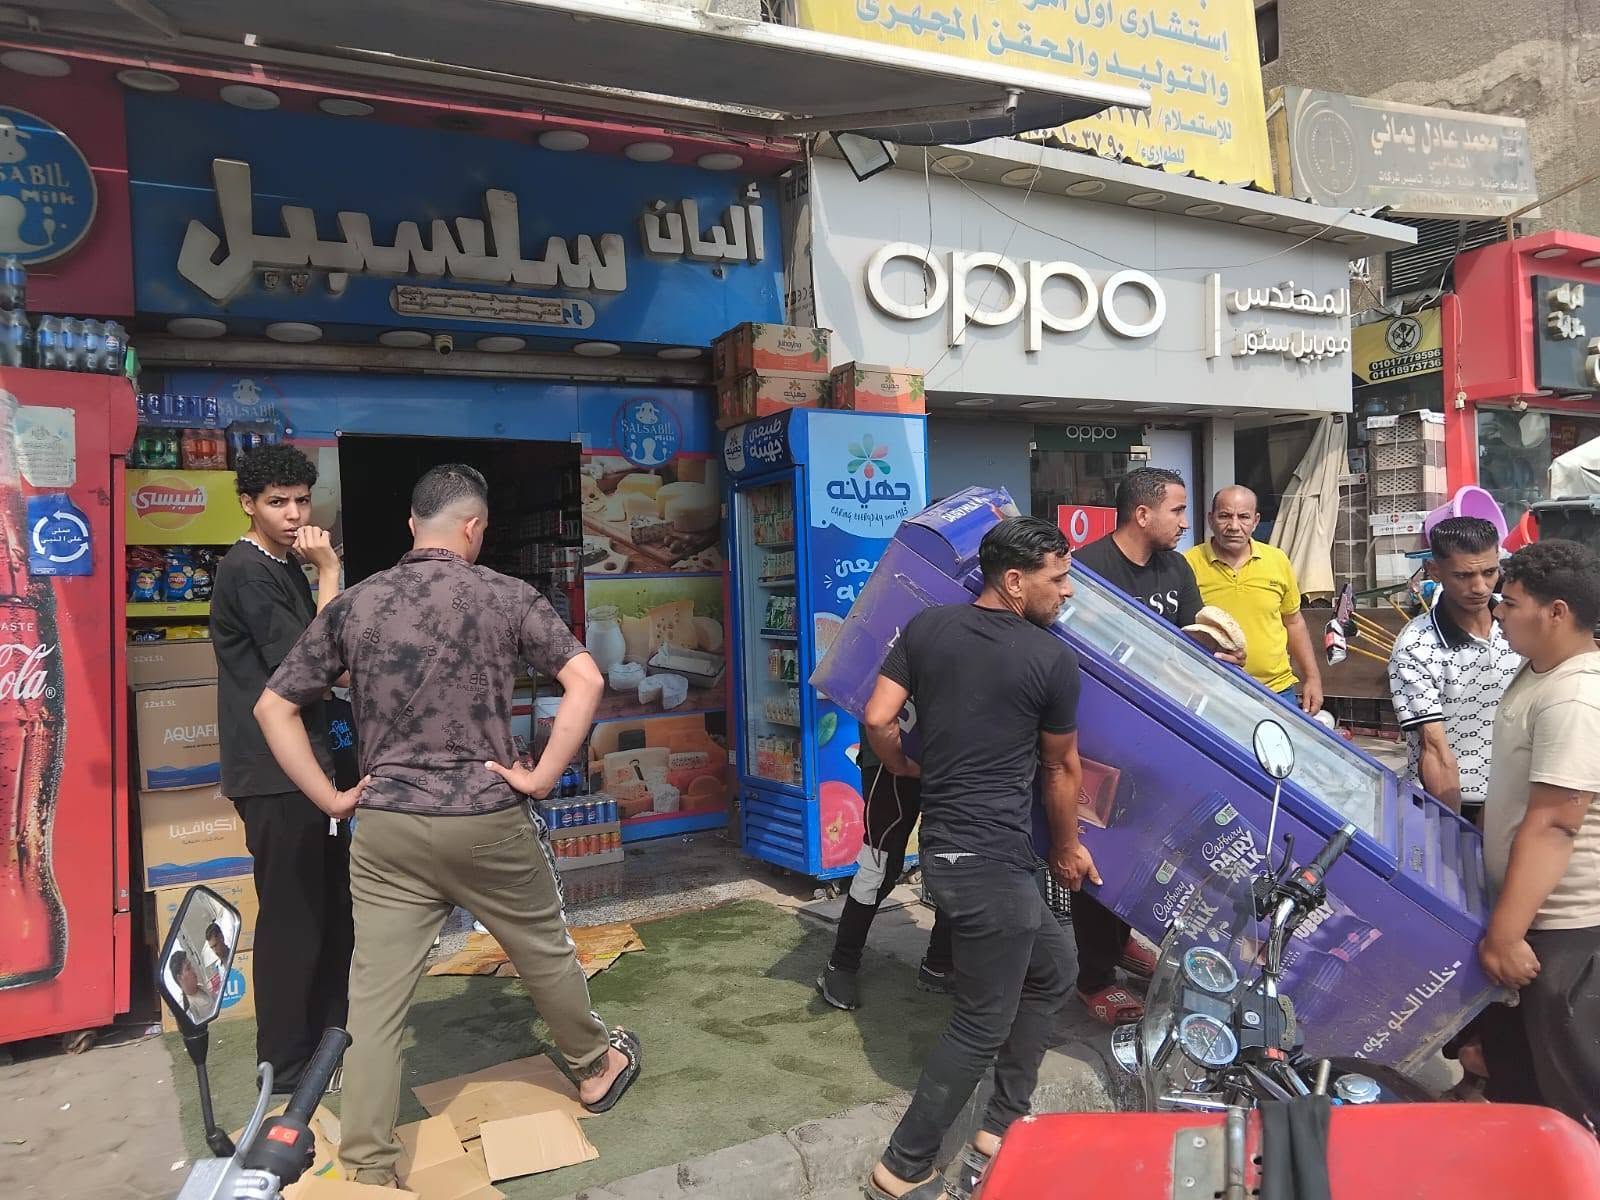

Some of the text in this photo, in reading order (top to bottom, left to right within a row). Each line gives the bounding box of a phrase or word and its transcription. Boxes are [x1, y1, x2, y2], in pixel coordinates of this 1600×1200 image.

[987, 20, 1099, 76] والحقن
[1106, 51, 1229, 106] والتوليد
[1371, 113, 1416, 157] يماني
[1422, 119, 1458, 155] عادل
[1464, 128, 1499, 152] محمد
[177, 158, 766, 301] ألبان سلسبيل
[865, 241, 1168, 354] oppo
[1232, 280, 1351, 316] المهندس
[1239, 328, 1351, 365] موبايل ستور
[621, 419, 674, 435] SALSABIL
[1066, 425, 1117, 443] oppo
[0, 622, 35, 632] ASTE
[162, 723, 218, 745] AQUAFI
[1201, 826, 1245, 861] Cadbury
[1209, 830, 1255, 873] DAIRY
[1152, 881, 1189, 922] Cadbury
